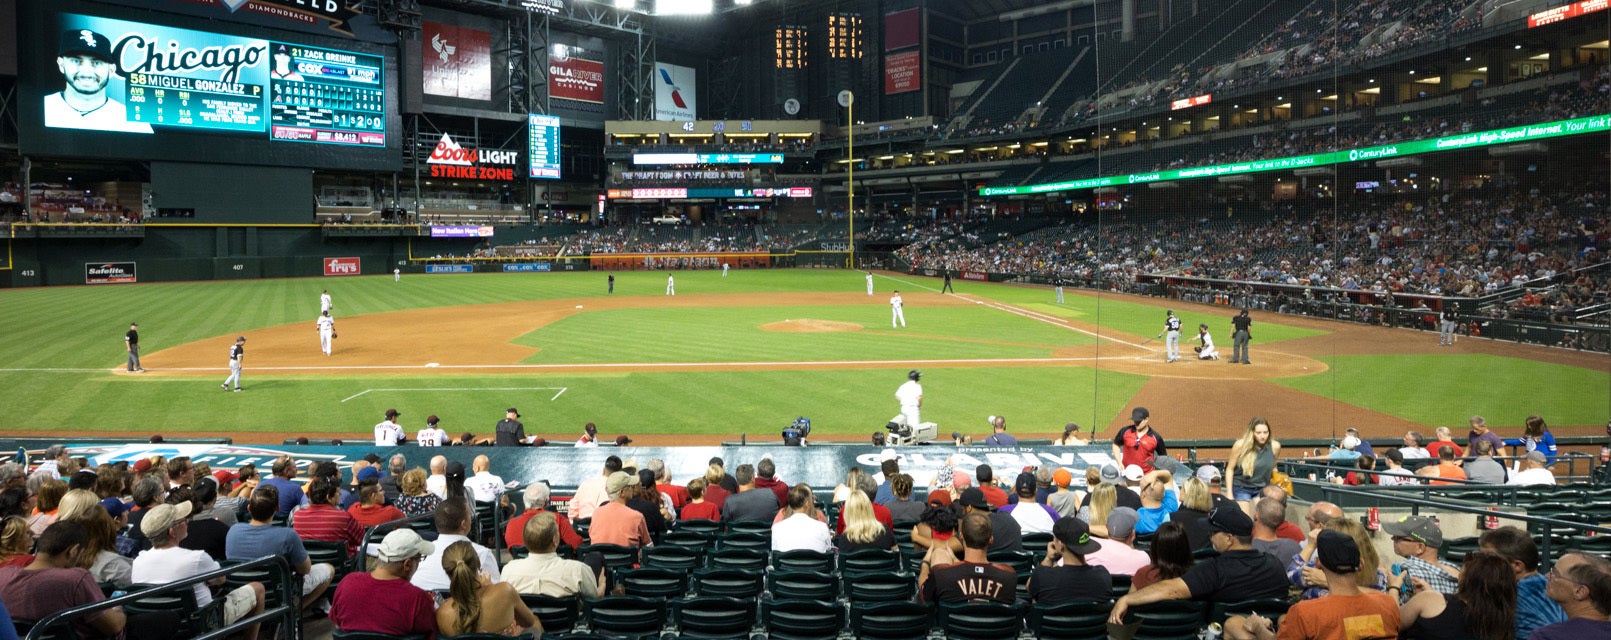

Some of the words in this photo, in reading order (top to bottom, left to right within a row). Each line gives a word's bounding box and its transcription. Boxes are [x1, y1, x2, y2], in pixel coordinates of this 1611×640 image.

[249, 3, 314, 22] DIAMONDBACKS
[110, 35, 266, 84] Chicago
[292, 48, 302, 56] 21
[304, 50, 324, 60] ZACK
[298, 62, 324, 74] COX
[550, 66, 573, 78] GILA
[573, 69, 603, 82] RIVER
[130, 73, 146, 84] 58
[148, 74, 194, 90] MIGUEL
[194, 79, 245, 95] GONZALEZ
[252, 86, 260, 96] P
[358, 116, 364, 126] 2
[374, 118, 381, 128] 0
[682, 122, 694, 131] 42
[334, 132, 357, 142] $8,412
[1480, 128, 1526, 144] High-Speed
[1566, 121, 1586, 130] Your
[1589, 118, 1604, 129] link
[431, 141, 478, 162] Coors
[479, 150, 518, 164] LIGHT
[1358, 146, 1398, 160] CenturyLink
[431, 165, 477, 179] STRIKE
[478, 167, 514, 180] ZONE
[1136, 173, 1160, 182] CenturyLink
[328, 259, 357, 273] fry's
[384, 430, 387, 440] 1
[985, 452, 1124, 466] RIVE
[957, 578, 1003, 599] VALET
